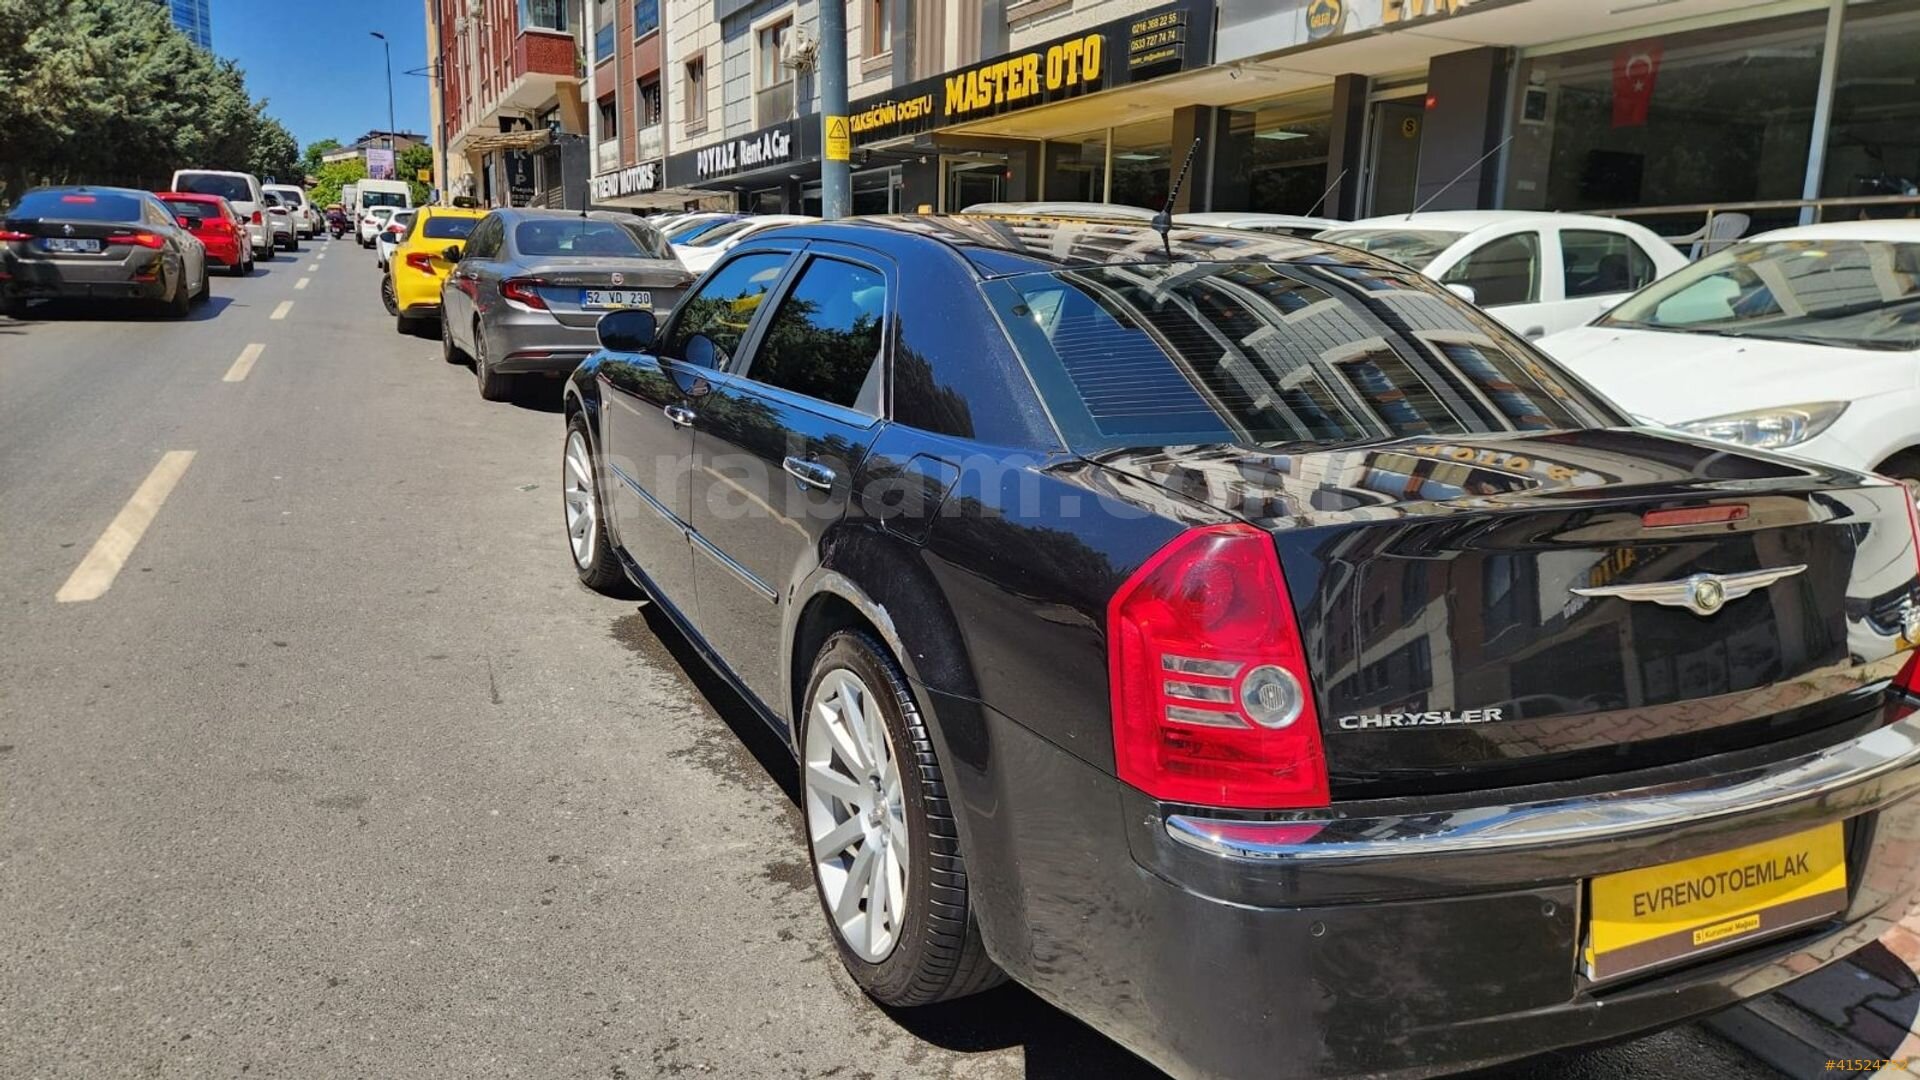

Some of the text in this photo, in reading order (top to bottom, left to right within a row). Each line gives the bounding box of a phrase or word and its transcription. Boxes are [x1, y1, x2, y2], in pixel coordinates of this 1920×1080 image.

[945, 33, 1101, 116] MASTER OTO
[897, 93, 933, 121] DOSTU
[697, 141, 736, 176] POYRAZ
[740, 137, 762, 167] Rent
[771, 129, 790, 158] Car
[620, 163, 656, 195] MOTORS
[587, 291, 649, 304] 52 VD 230
[1339, 708, 1503, 729] CHRYSLER
[1633, 852, 1809, 917] EVRENOTOEMLAK
